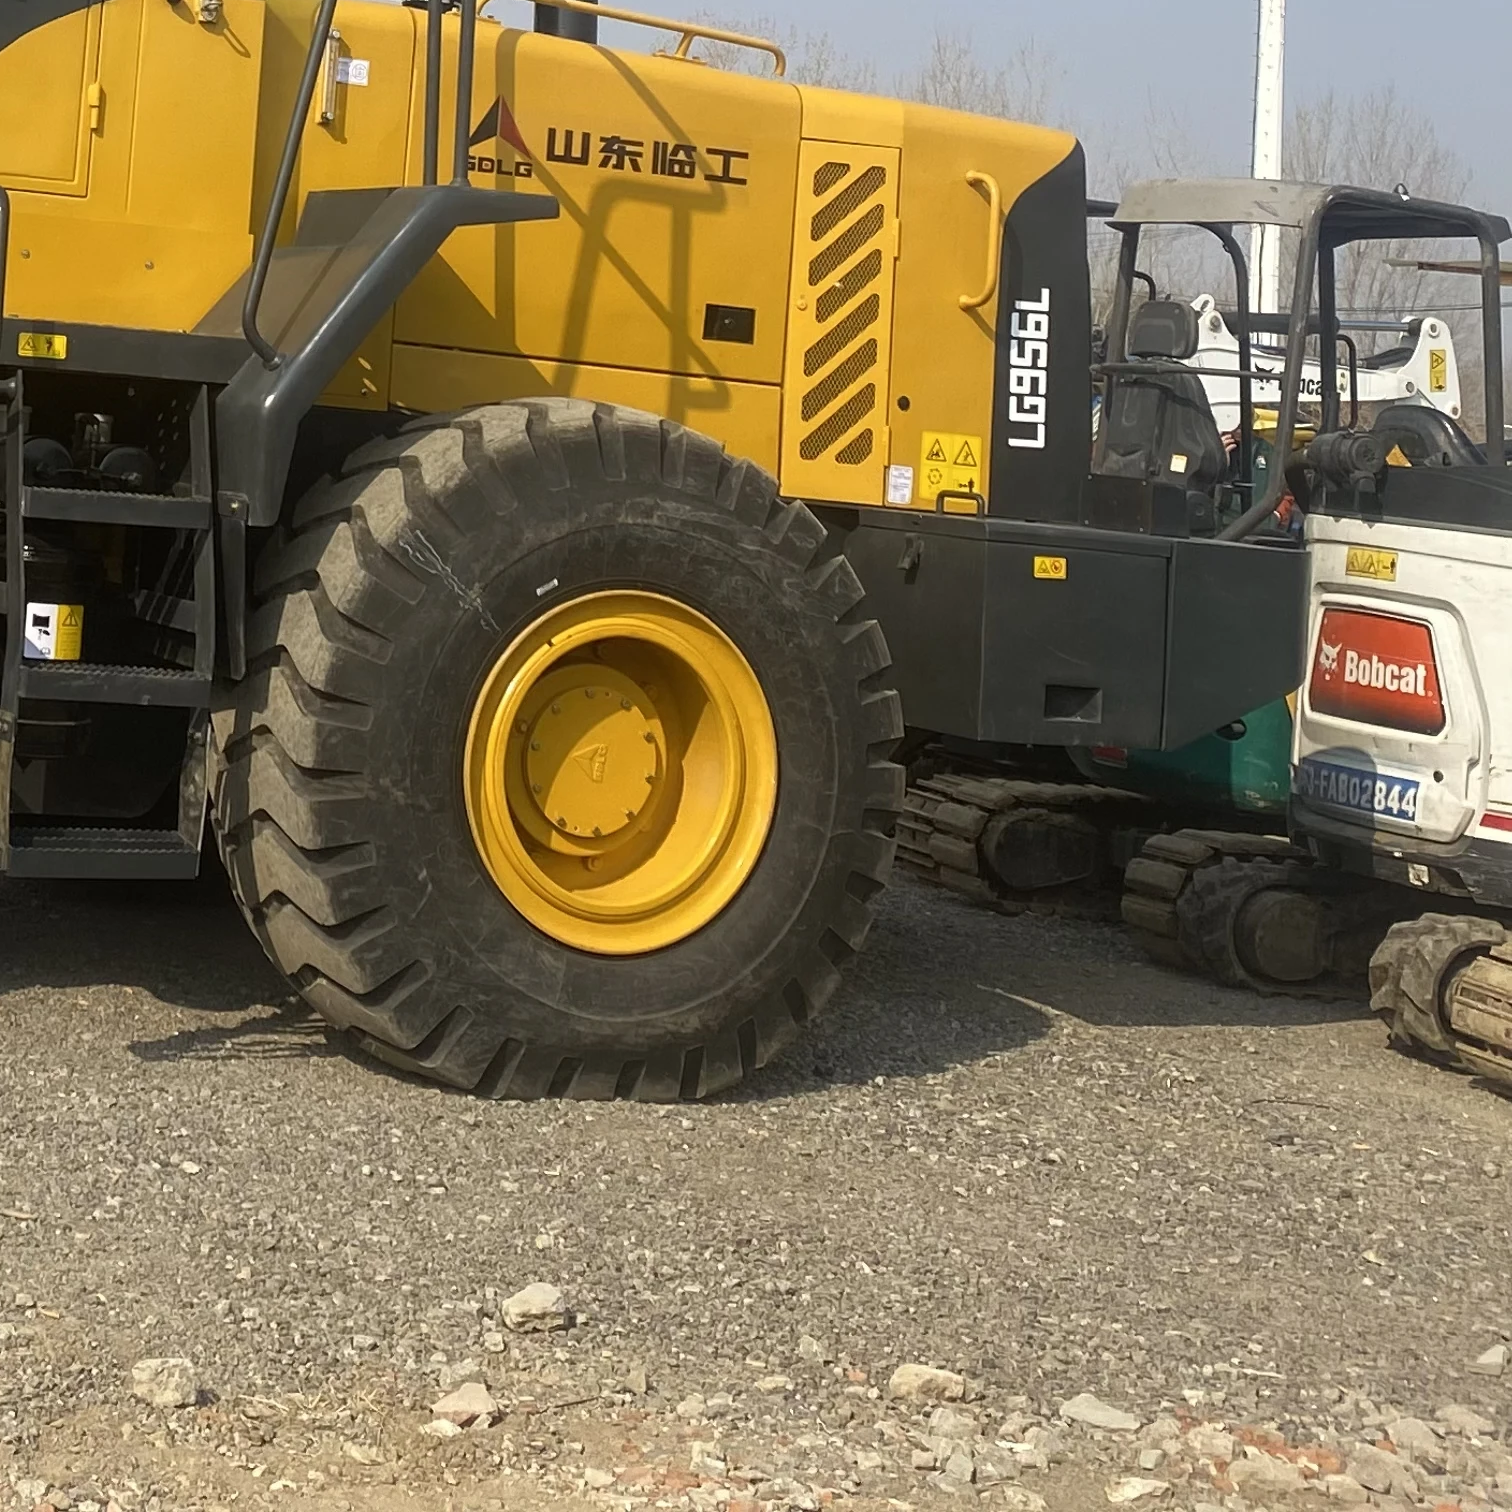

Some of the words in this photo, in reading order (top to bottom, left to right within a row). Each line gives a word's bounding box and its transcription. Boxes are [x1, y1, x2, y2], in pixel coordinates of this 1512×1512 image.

[546, 127, 749, 186] 山东临工
[1007, 287, 1051, 449] LG956L
[1344, 649, 1427, 697] Bobcat
